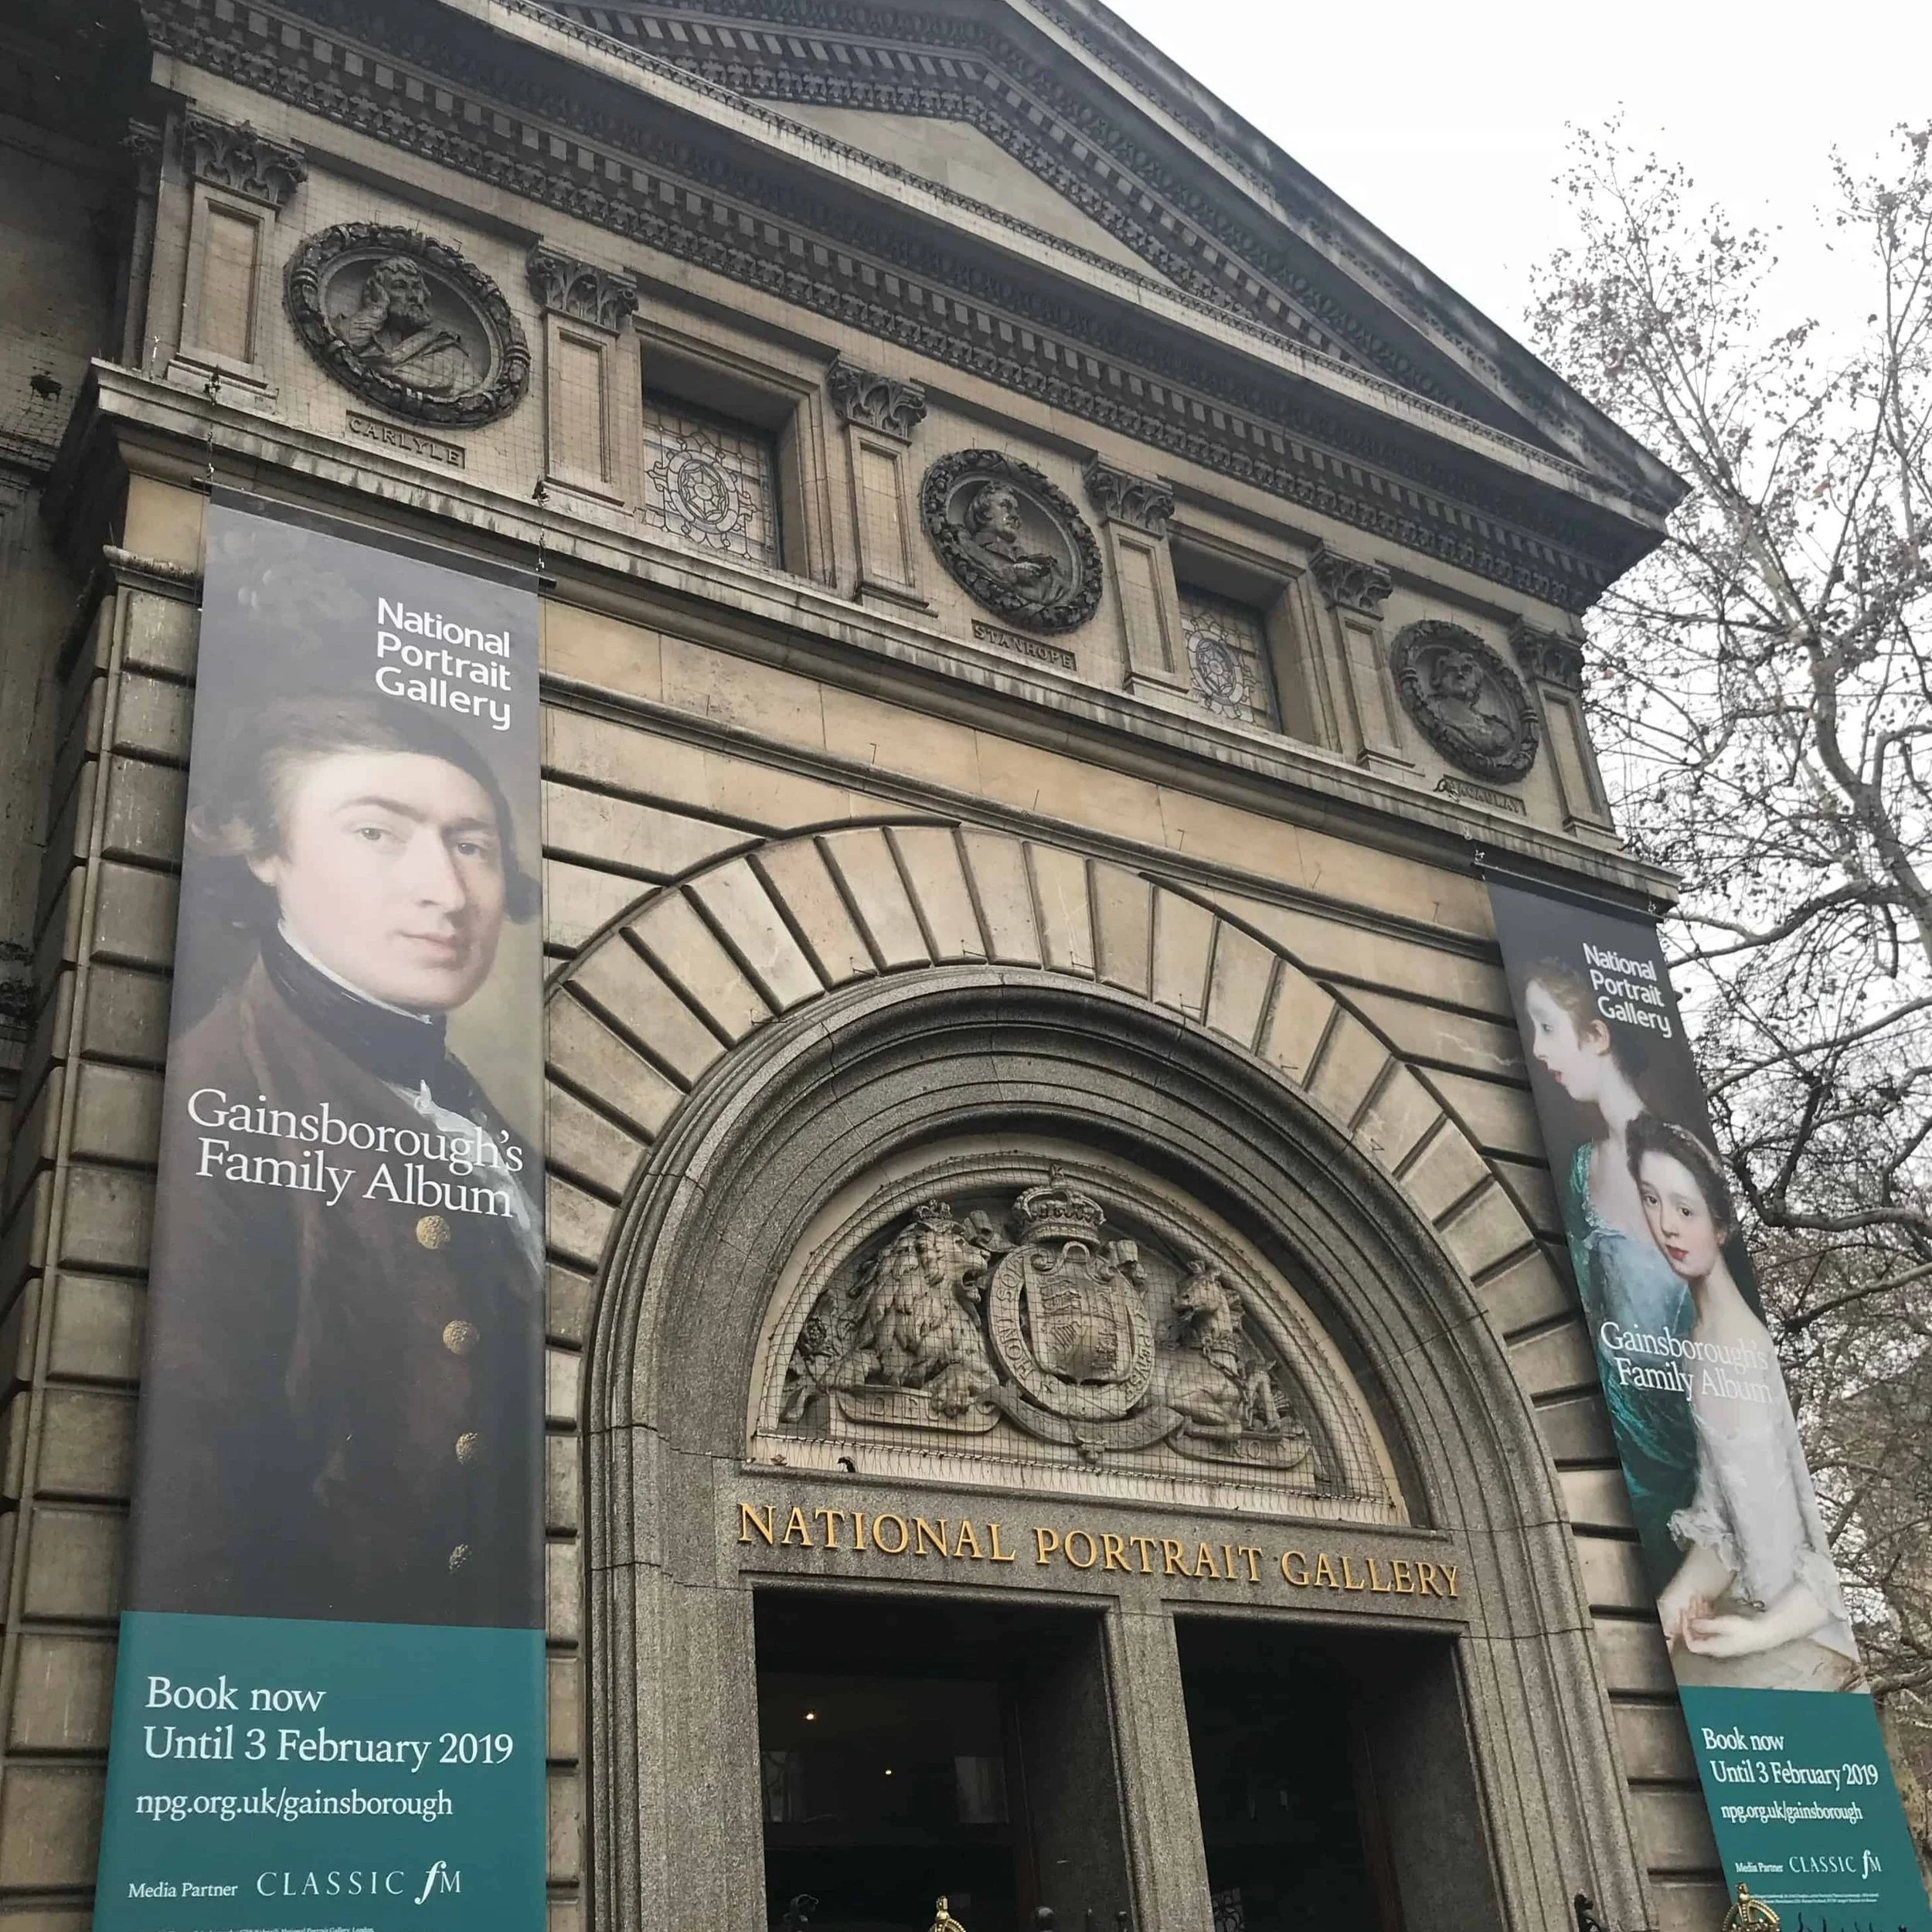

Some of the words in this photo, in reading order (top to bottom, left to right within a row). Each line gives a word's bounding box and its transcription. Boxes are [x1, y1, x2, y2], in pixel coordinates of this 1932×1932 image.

[349, 419, 459, 466] CARLYLE
[378, 597, 510, 658] National
[975, 624, 1073, 669] STANHOPE
[377, 631, 512, 691] Portrait
[376, 666, 510, 731] Gallery
[1583, 942, 1658, 981] National
[1590, 968, 1665, 1007] Portrait
[1597, 995, 1672, 1038] Gallery
[188, 1088, 523, 1175] Gainsborough's
[196, 1138, 355, 1206] Family
[362, 1162, 513, 1218] Album
[1600, 1321, 1768, 1374] Gainsborough's
[1614, 1357, 1694, 1401] Family
[1702, 1368, 1773, 1403] Album
[738, 1502, 1015, 1562] NATIONAL
[1032, 1527, 1263, 1583] PORTRAIT
[1281, 1551, 1459, 1598] GALLERY
[145, 1675, 239, 1711] Book
[250, 1686, 326, 1713] now
[143, 1725, 233, 1760] Until
[244, 1728, 266, 1760] 3
[277, 1727, 431, 1772] February
[439, 1733, 513, 1764] 2019
[1702, 1726, 1748, 1750] Book
[1750, 1734, 1784, 1751] now
[1710, 1760, 1755, 1784] Until
[1758, 1761, 1770, 1784] 3
[1770, 1760, 1841, 1791] February
[1842, 1764, 1879, 1786] 2019
[135, 1787, 453, 1822] npg.org.uk/gainsborough
[1721, 1801, 1864, 1825] npg.org.uk/gainsborough
[128, 1882, 177, 1898] Media
[182, 1883, 238, 1897] Partner
[257, 1871, 404, 1896] CLASSIC
[1735, 1862, 1758, 1872] Media
[1759, 1862, 1784, 1872] Partner
[1789, 1856, 1856, 1872] CLASSIC
